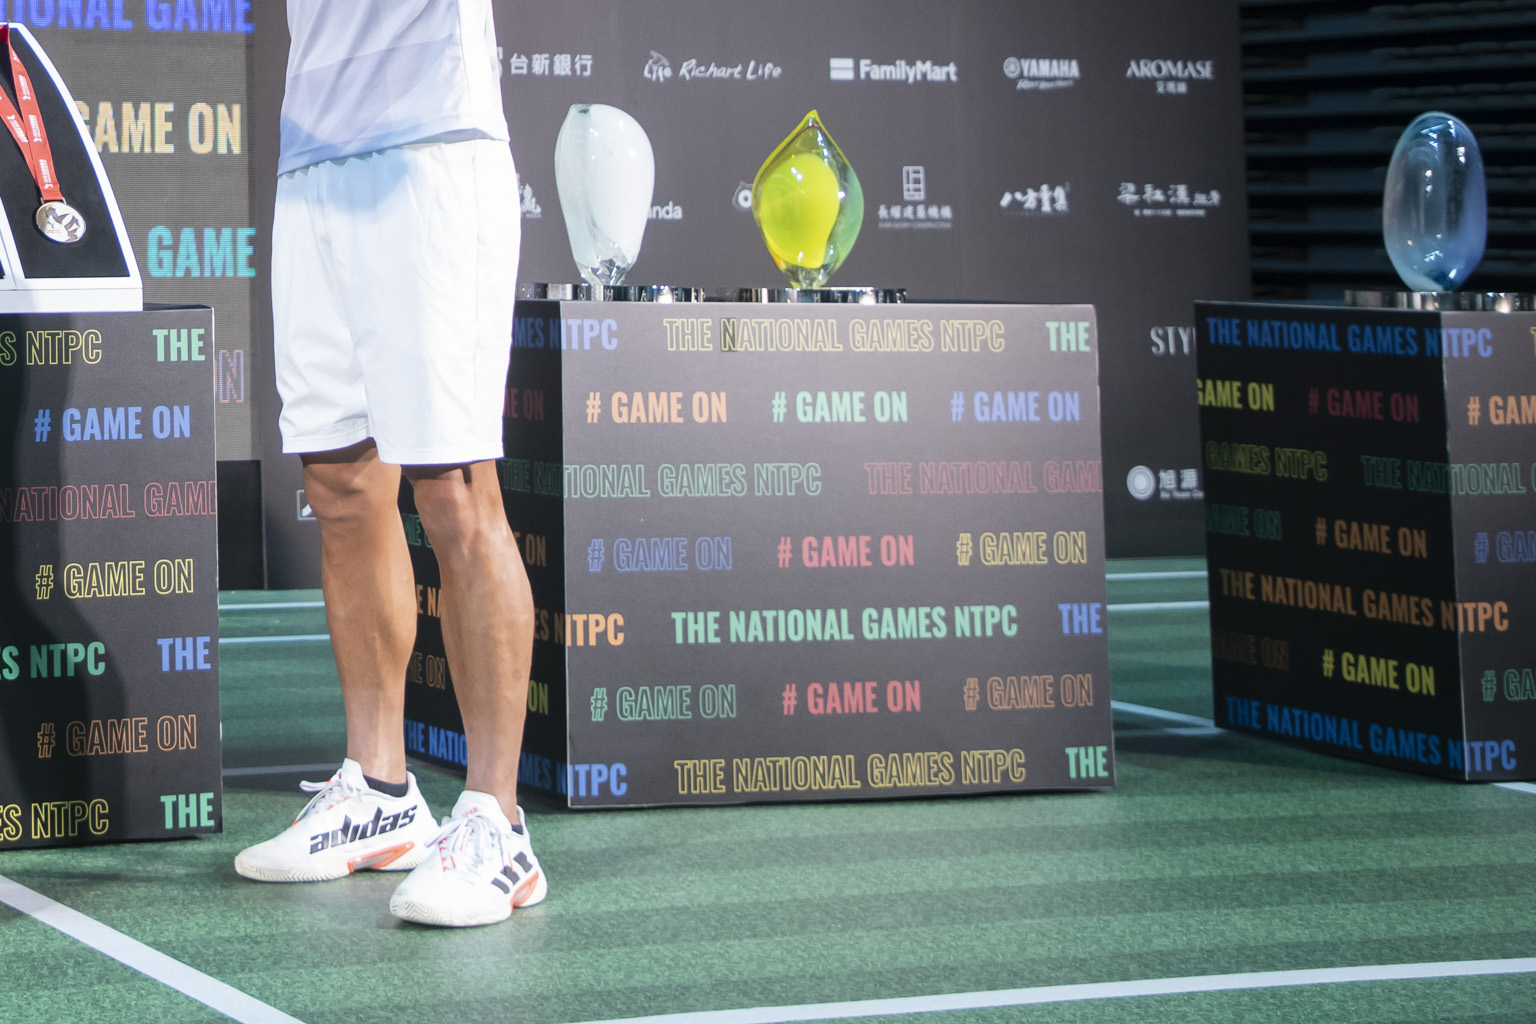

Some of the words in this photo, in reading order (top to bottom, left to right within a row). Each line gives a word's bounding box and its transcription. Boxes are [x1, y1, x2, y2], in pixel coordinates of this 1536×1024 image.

[509, 53, 594, 76] 台新銀行
[678, 58, 743, 81] Richart
[745, 59, 783, 81] Life
[860, 58, 959, 83] FamilyMart
[1018, 58, 1081, 77] YAMAHA
[1125, 58, 1214, 81] AROMASE
[188, 102, 242, 155] ON
[146, 225, 256, 278] GAME
[153, 328, 205, 362] THE
[664, 318, 712, 352] THE
[721, 317, 843, 352] NATIONAL
[849, 319, 934, 352] GAMES
[941, 320, 1005, 352] NTPC
[1206, 318, 1242, 348] THE
[1247, 320, 1341, 352] NATIONAL
[1347, 325, 1418, 357] GAMES
[63, 406, 142, 442] GAME
[152, 405, 191, 438] ON
[611, 392, 683, 423] GAME
[692, 391, 727, 422] ON
[974, 391, 1040, 421] GAME
[1049, 391, 1080, 421] ON
[802, 536, 871, 568] GAME
[880, 535, 914, 566] ON
[980, 532, 1046, 565] GAME
[1053, 531, 1087, 563] ON
[1334, 519, 1391, 555] GAME
[1398, 526, 1427, 560] ON
[64, 560, 145, 598] GAME
[154, 558, 193, 594] ON
[672, 611, 721, 644] THE
[729, 609, 853, 643] NATIONAL
[862, 606, 947, 641] GAMES
[954, 605, 1017, 638] NTPC
[30, 641, 105, 679] NTPC
[1341, 652, 1400, 690] GAME
[1405, 662, 1435, 697] ON
[1226, 696, 1261, 730] THE
[1267, 702, 1363, 750] NATIONAL
[1369, 724, 1441, 766] GAMES
[675, 759, 726, 794] THE
[734, 755, 860, 792] NATIONAL
[868, 752, 954, 788] GAMES
[962, 749, 1025, 785] NTPC
[32, 798, 108, 837] NTPC
[309, 804, 418, 855] adidas
